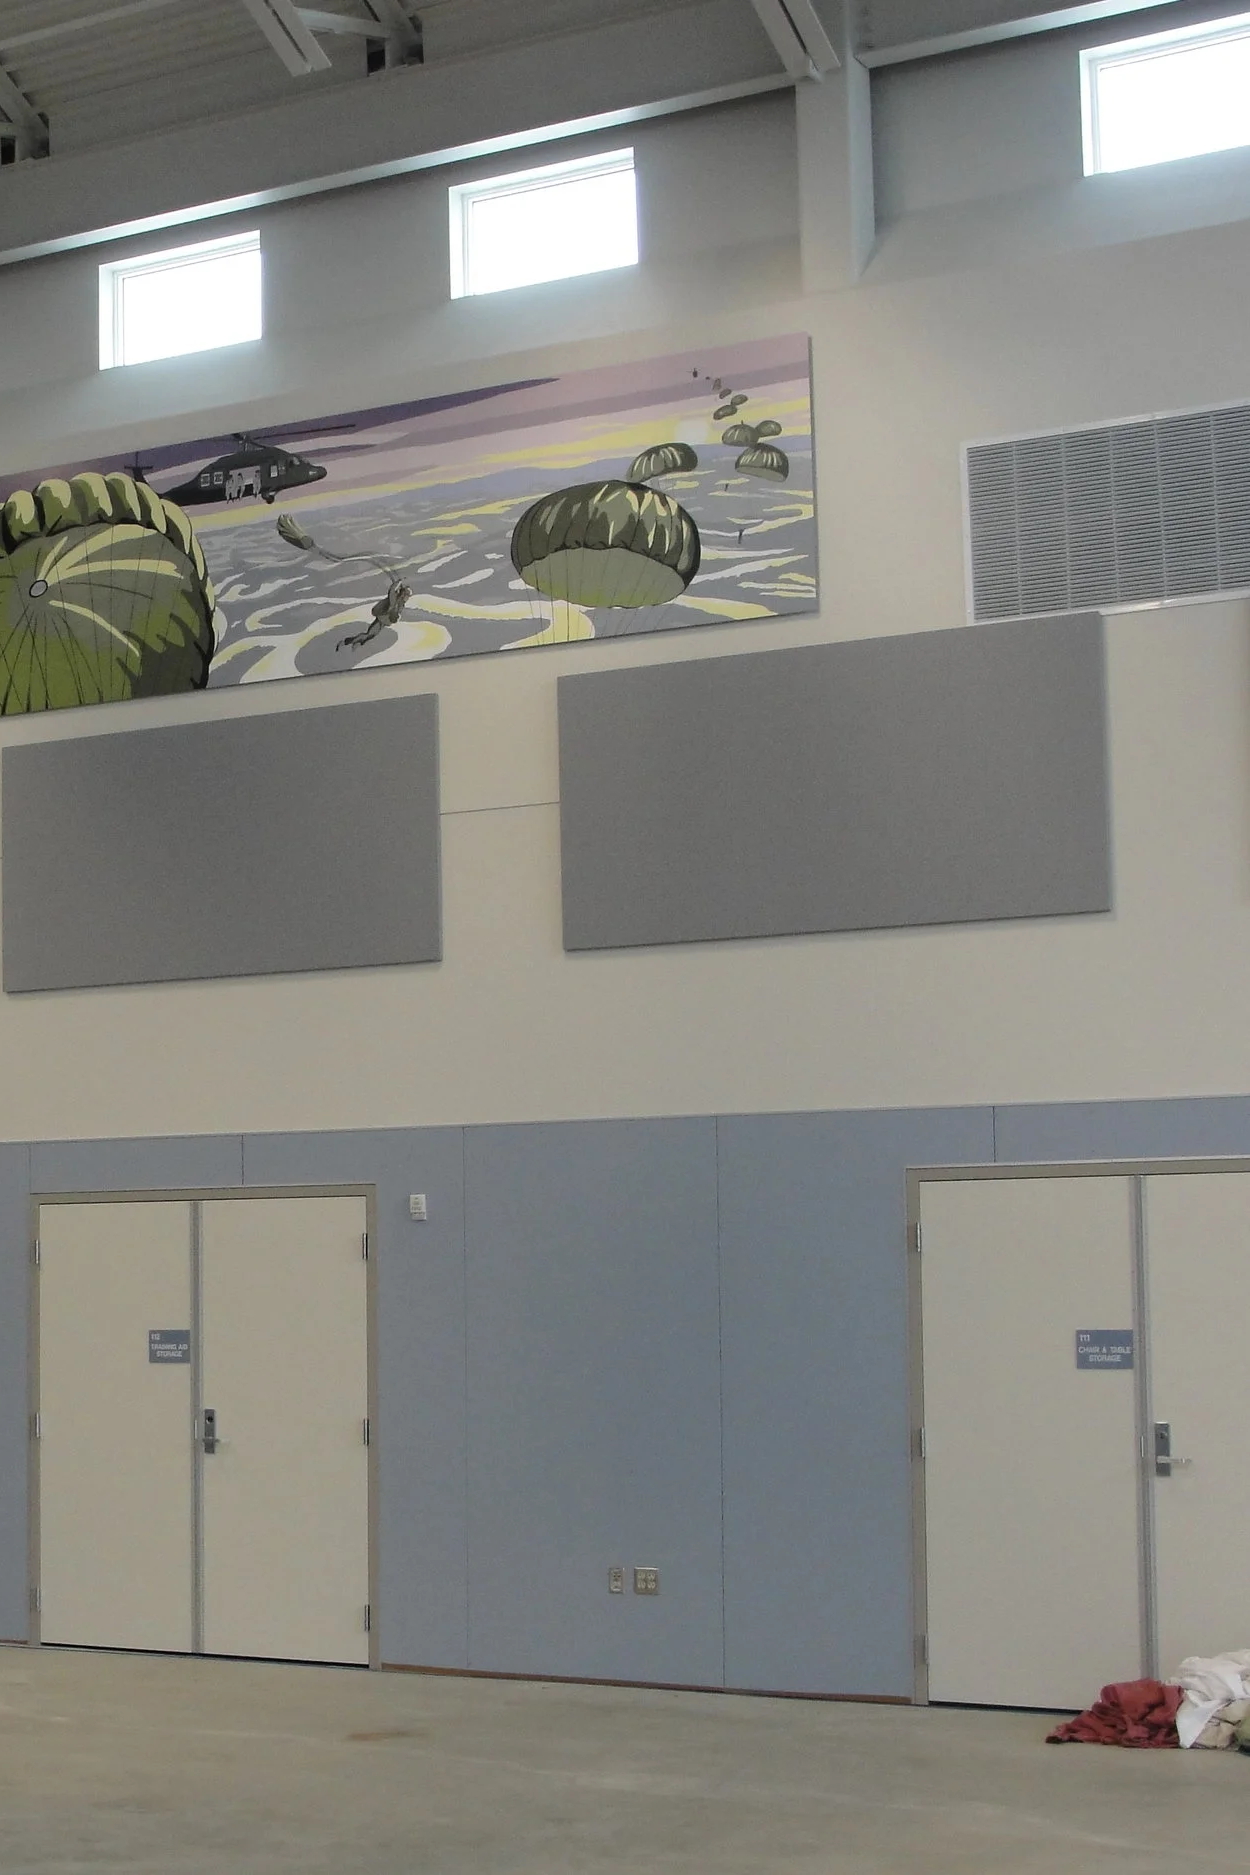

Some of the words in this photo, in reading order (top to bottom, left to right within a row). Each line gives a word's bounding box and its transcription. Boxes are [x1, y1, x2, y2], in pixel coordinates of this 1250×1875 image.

[156, 1350, 182, 1358] STORAGE
[1110, 1346, 1131, 1354] TABLE
[1089, 1354, 1122, 1362] STORAGE
